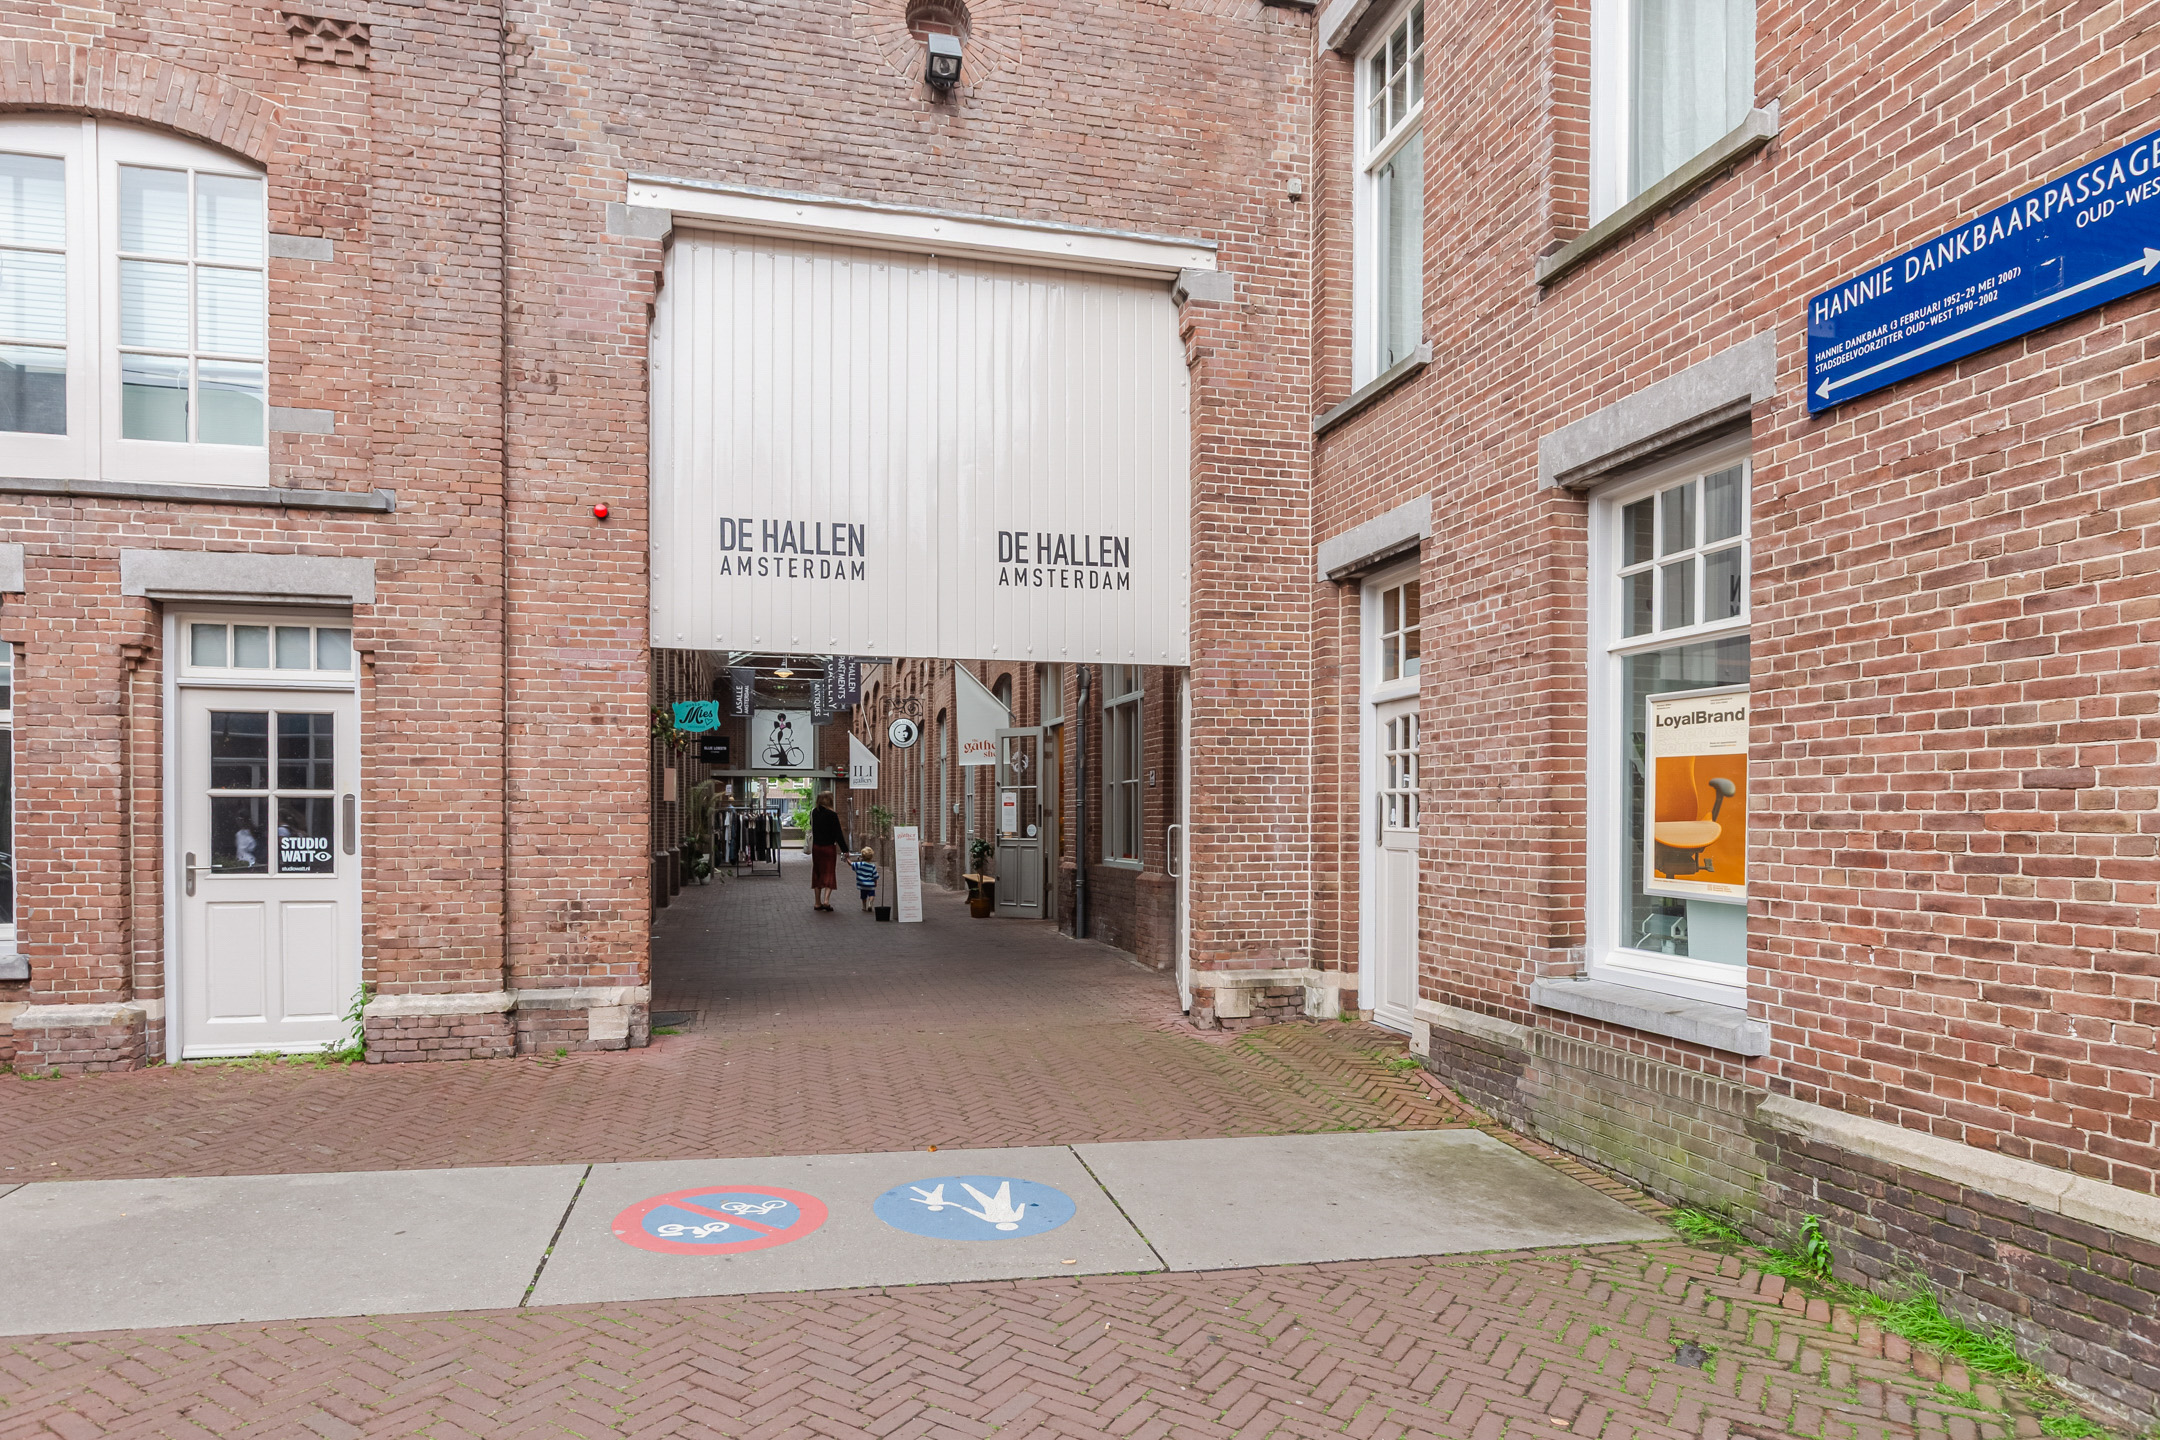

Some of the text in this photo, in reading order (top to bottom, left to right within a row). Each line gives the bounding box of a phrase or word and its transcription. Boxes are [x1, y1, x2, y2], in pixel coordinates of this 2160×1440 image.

[2076, 176, 2160, 229] OUD-WES
[1815, 137, 2160, 325] HANNIE DANKBAARPASSAGE
[1815, 266, 2022, 363] HANNIE DANKBAAR (3 FEBRUARI 1952-29 MEI 2007)
[1815, 289, 1999, 375] STADSDEELVOORZITTER OUD-WEST 1990-2002
[720, 517, 865, 557] DE HALLEN
[998, 530, 1130, 568] DE HALLEN
[720, 555, 865, 581] AMSTERDAM
[998, 566, 1130, 591] AMSTERDAM
[837, 656, 846, 699] PARTMENTS
[848, 662, 856, 693] HALLEN
[679, 705, 713, 724] Mies
[1656, 707, 1745, 729] LoyalBrand
[281, 837, 328, 849] STUDIO
[281, 851, 316, 862] WATT
